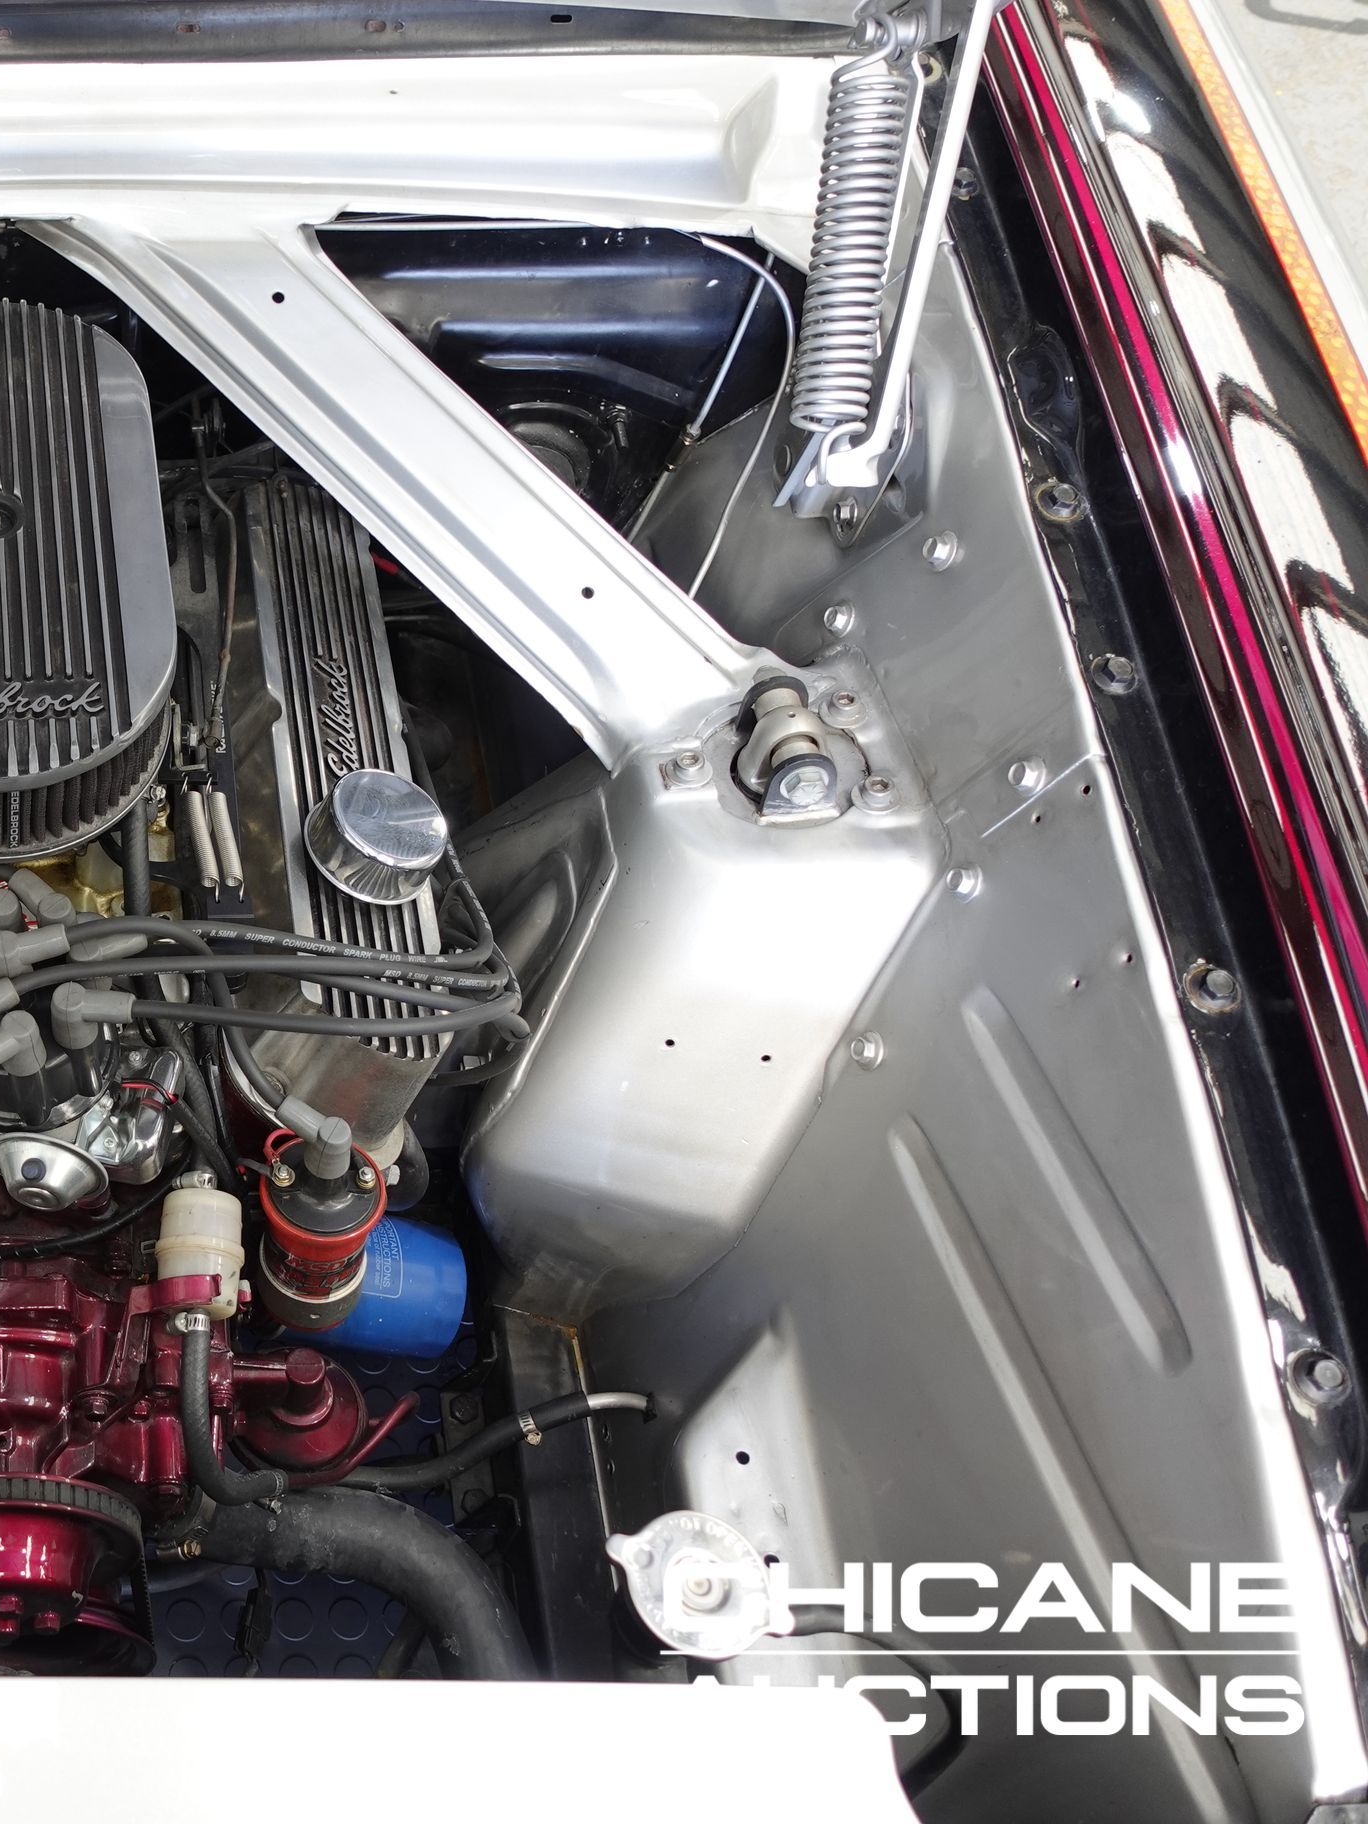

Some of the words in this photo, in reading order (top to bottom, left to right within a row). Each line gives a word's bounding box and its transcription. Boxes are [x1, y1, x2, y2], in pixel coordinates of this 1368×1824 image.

[313, 657, 361, 777] Edelbrock
[10, 791, 20, 848] EDELBROCK
[209, 929, 238, 939] 8.5MM
[244, 932, 275, 944] SUPER
[282, 938, 337, 954] CONDUCTOR
[343, 948, 373, 960] SPARK
[379, 953, 402, 962] PLUG
[383, 969, 402, 978] MSD
[432, 975, 454, 985] SUPER
[378, 1222, 392, 1288] NSTRUCTIONS
